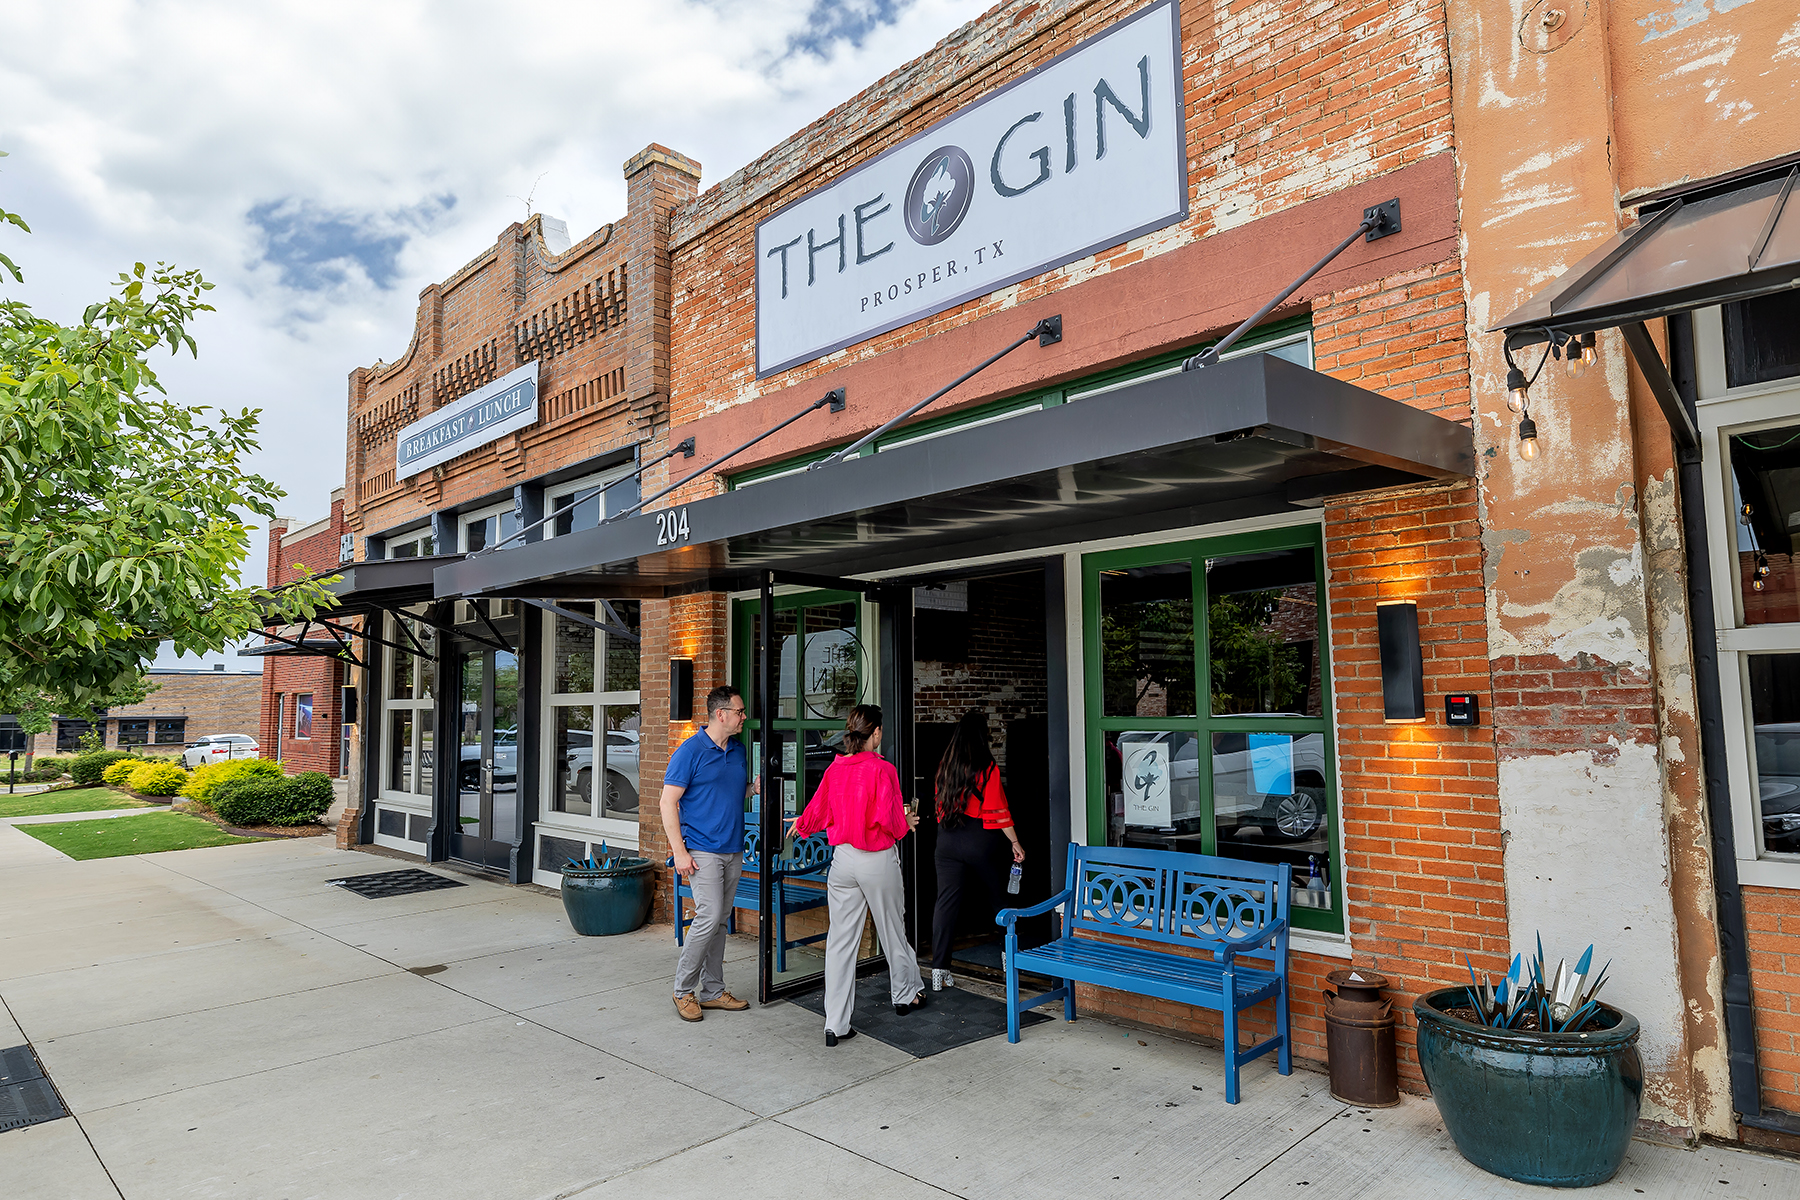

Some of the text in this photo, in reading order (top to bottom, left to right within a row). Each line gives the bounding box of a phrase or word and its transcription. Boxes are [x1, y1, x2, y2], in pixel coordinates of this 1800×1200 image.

[767, 54, 1152, 301] THE GIN
[860, 239, 1005, 313] PROSPER, TX
[406, 389, 522, 459] BREAKFAST LUNCH
[656, 507, 690, 546] 204
[1133, 803, 1160, 812] THE GIN
